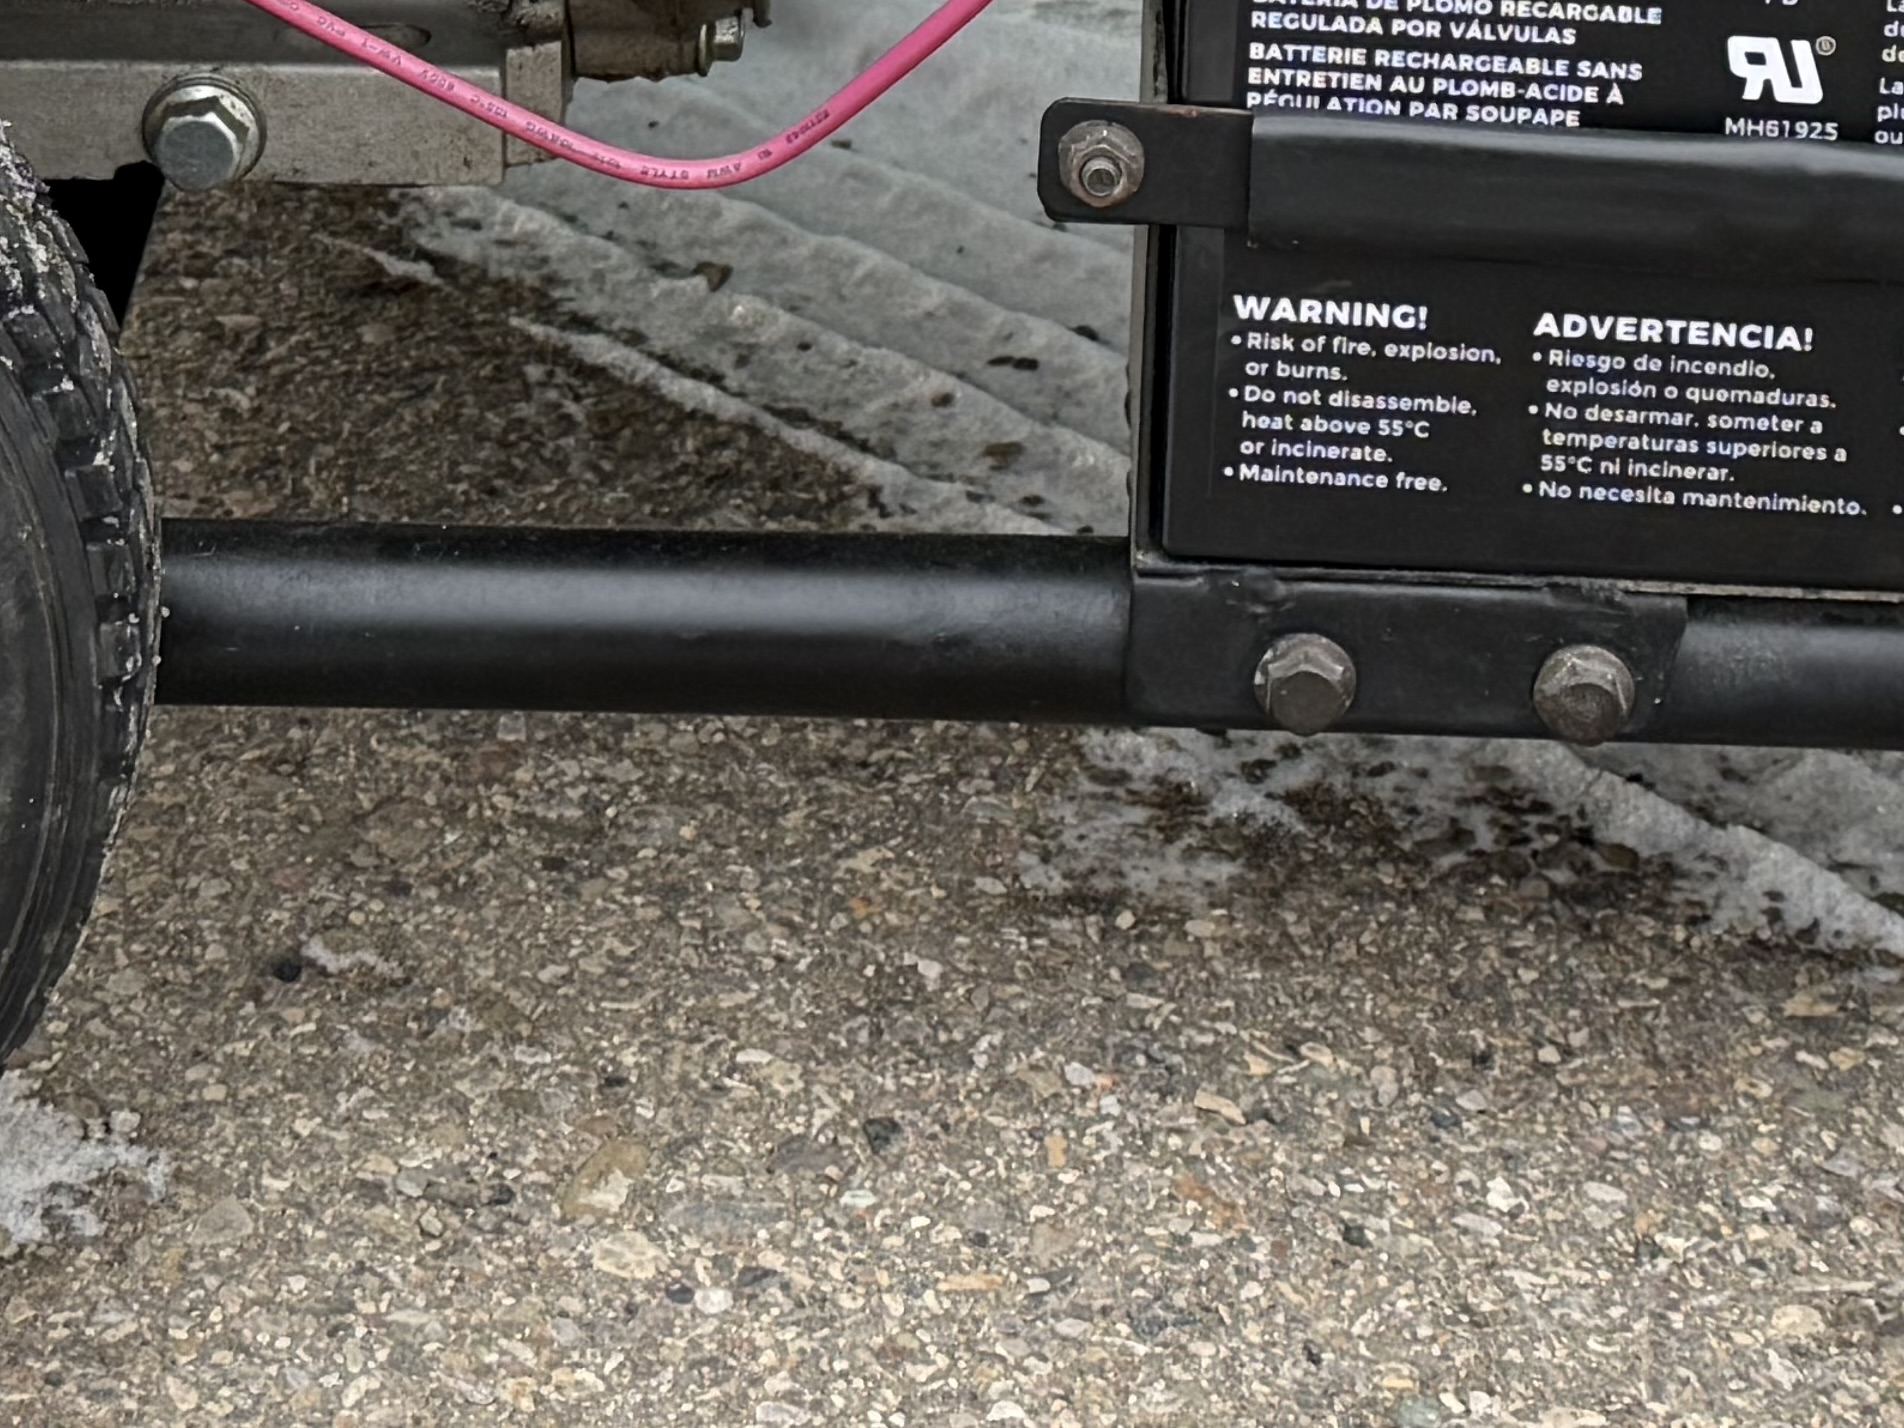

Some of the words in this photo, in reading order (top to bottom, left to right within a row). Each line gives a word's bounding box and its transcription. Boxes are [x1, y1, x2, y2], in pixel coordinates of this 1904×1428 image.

[1500, 0, 1662, 25] RECARGABLE
[1251, 10, 1383, 35] REGULADA
[1391, 18, 1441, 38] POR
[1449, 18, 1576, 45] VÁLVULAS
[1249, 42, 1367, 66] BATTERIE
[1374, 49, 1569, 76] RECHARGEABLE
[1576, 60, 1642, 81] SANS
[1247, 66, 1382, 91] ENTRETIEN
[1389, 75, 1425, 94] AU
[1432, 77, 1599, 103] PLOMB-ACIDE
[1606, 82, 1624, 105] À
[1409, 103, 1458, 122] PAR
[1466, 104, 1580, 127] SOUPAPE
[1726, 117, 1839, 140] MH61925
[1233, 294, 1427, 330] WARNING!
[1247, 331, 1294, 351] Risk
[1300, 335, 1326, 352] of
[1533, 312, 1813, 351] ADVERTENCIA!
[1244, 361, 1269, 376] or
[1276, 359, 1347, 380] burns.
[1548, 348, 1626, 373] Riesgo
[1633, 353, 1662, 371] de
[1244, 384, 1276, 403] Do
[1283, 389, 1321, 405] not
[1546, 376, 1656, 398] explosión
[1664, 385, 1678, 399] o
[1685, 386, 1836, 408] quemaduras.
[1242, 410, 1293, 430] heat
[1299, 414, 1371, 435] above
[1378, 418, 1429, 438] 55°C
[1240, 440, 1265, 455] or
[1271, 438, 1392, 462] incinerate.
[1239, 463, 1388, 488] Maintenance
[1395, 471, 1447, 491] free.
[1538, 480, 1572, 499] No
[1578, 485, 1675, 505] necesita
[1682, 491, 1866, 515] mantenimiento.
